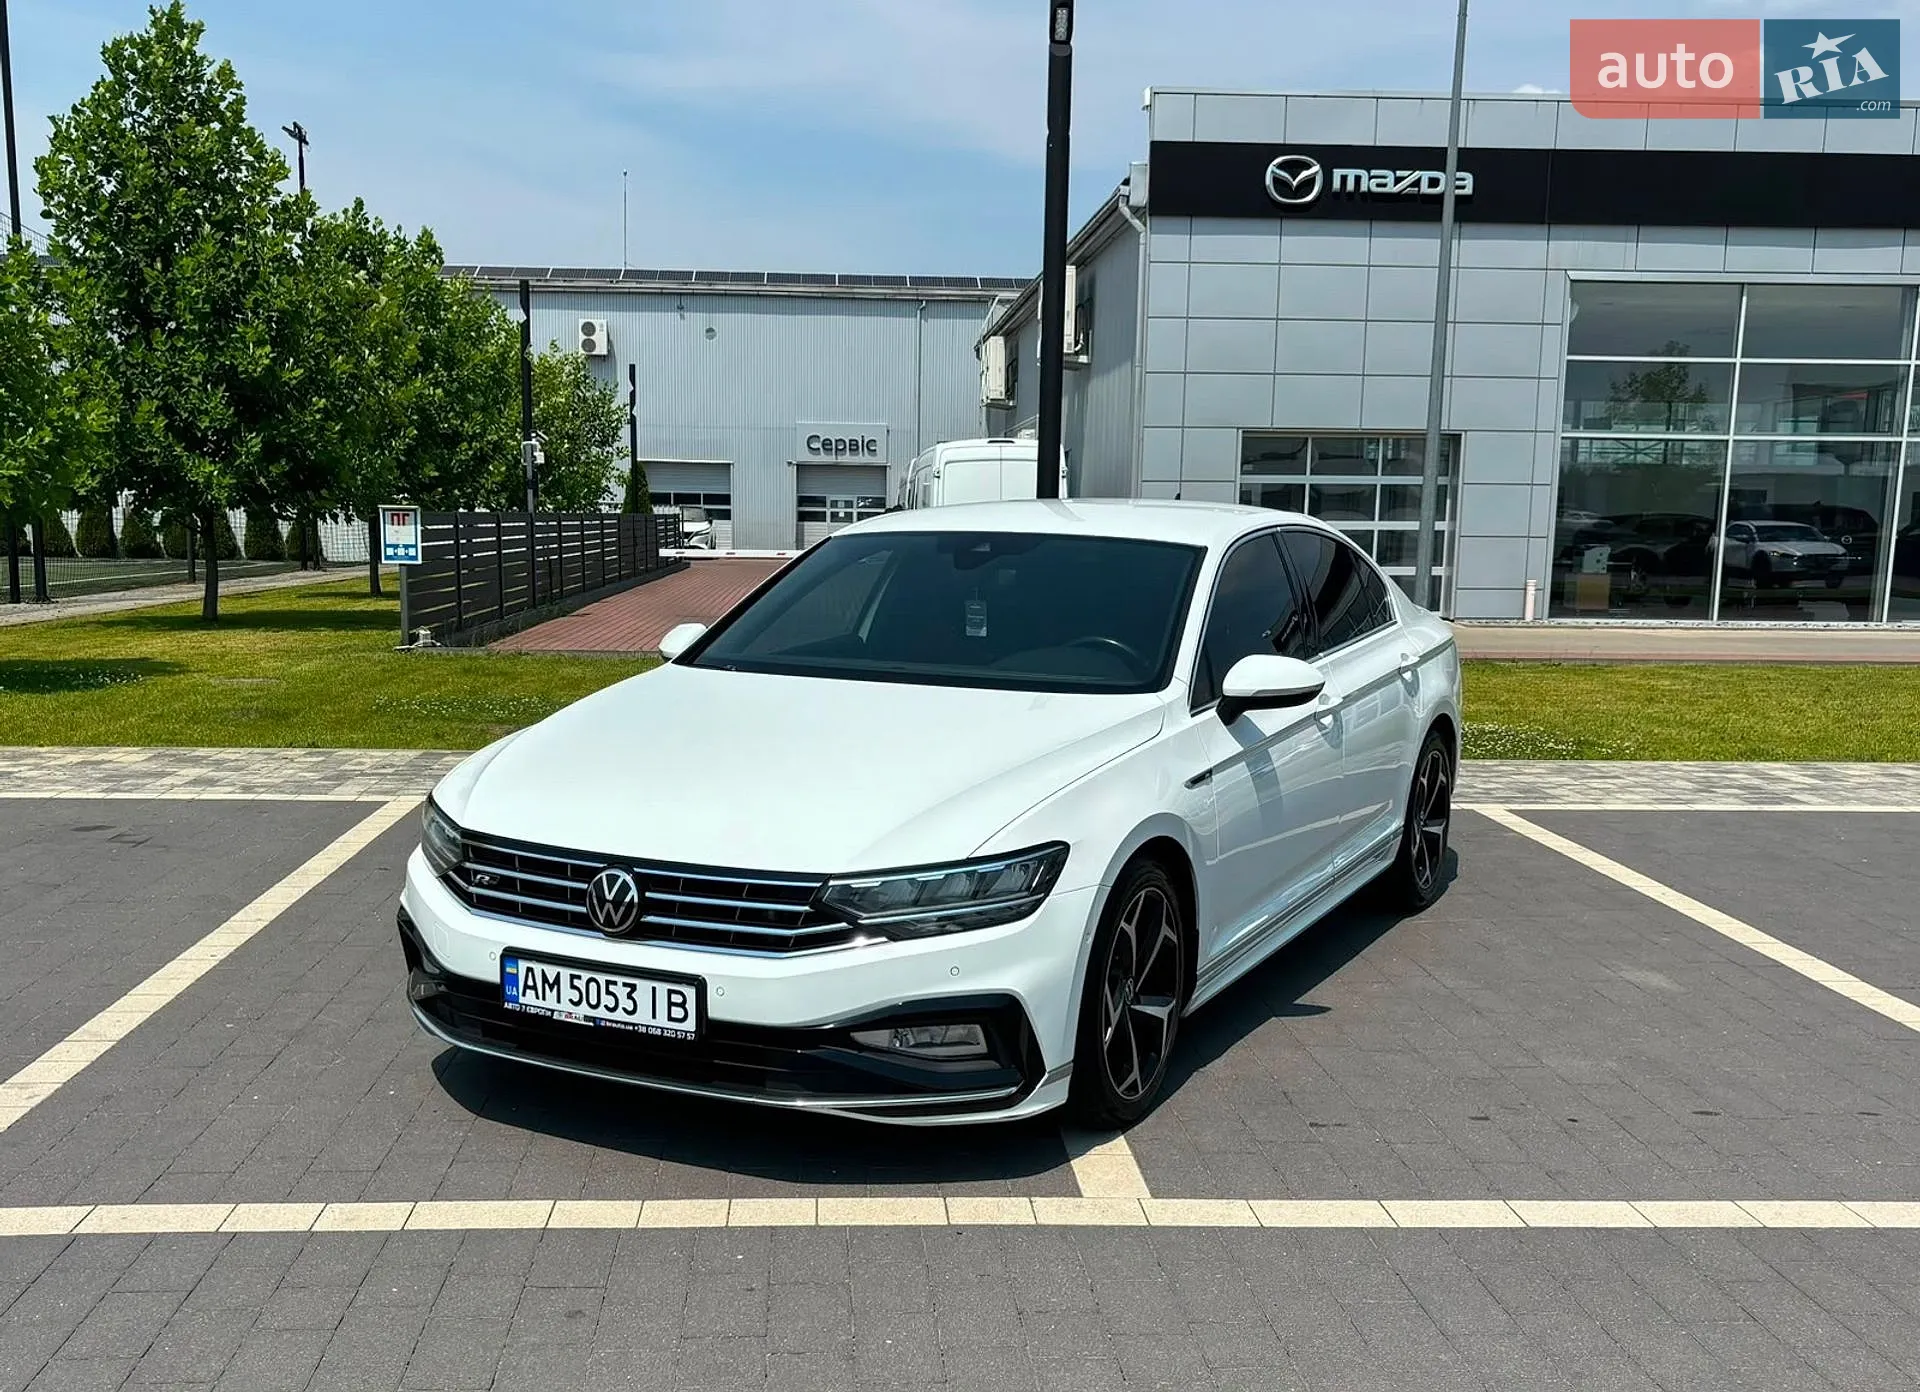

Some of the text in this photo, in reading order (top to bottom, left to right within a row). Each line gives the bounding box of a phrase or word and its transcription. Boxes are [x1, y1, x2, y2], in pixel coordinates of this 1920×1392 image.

[806, 434, 877, 459] Сервіс
[505, 986, 518, 996] UA
[521, 966, 689, 1024] AM 5053 IB
